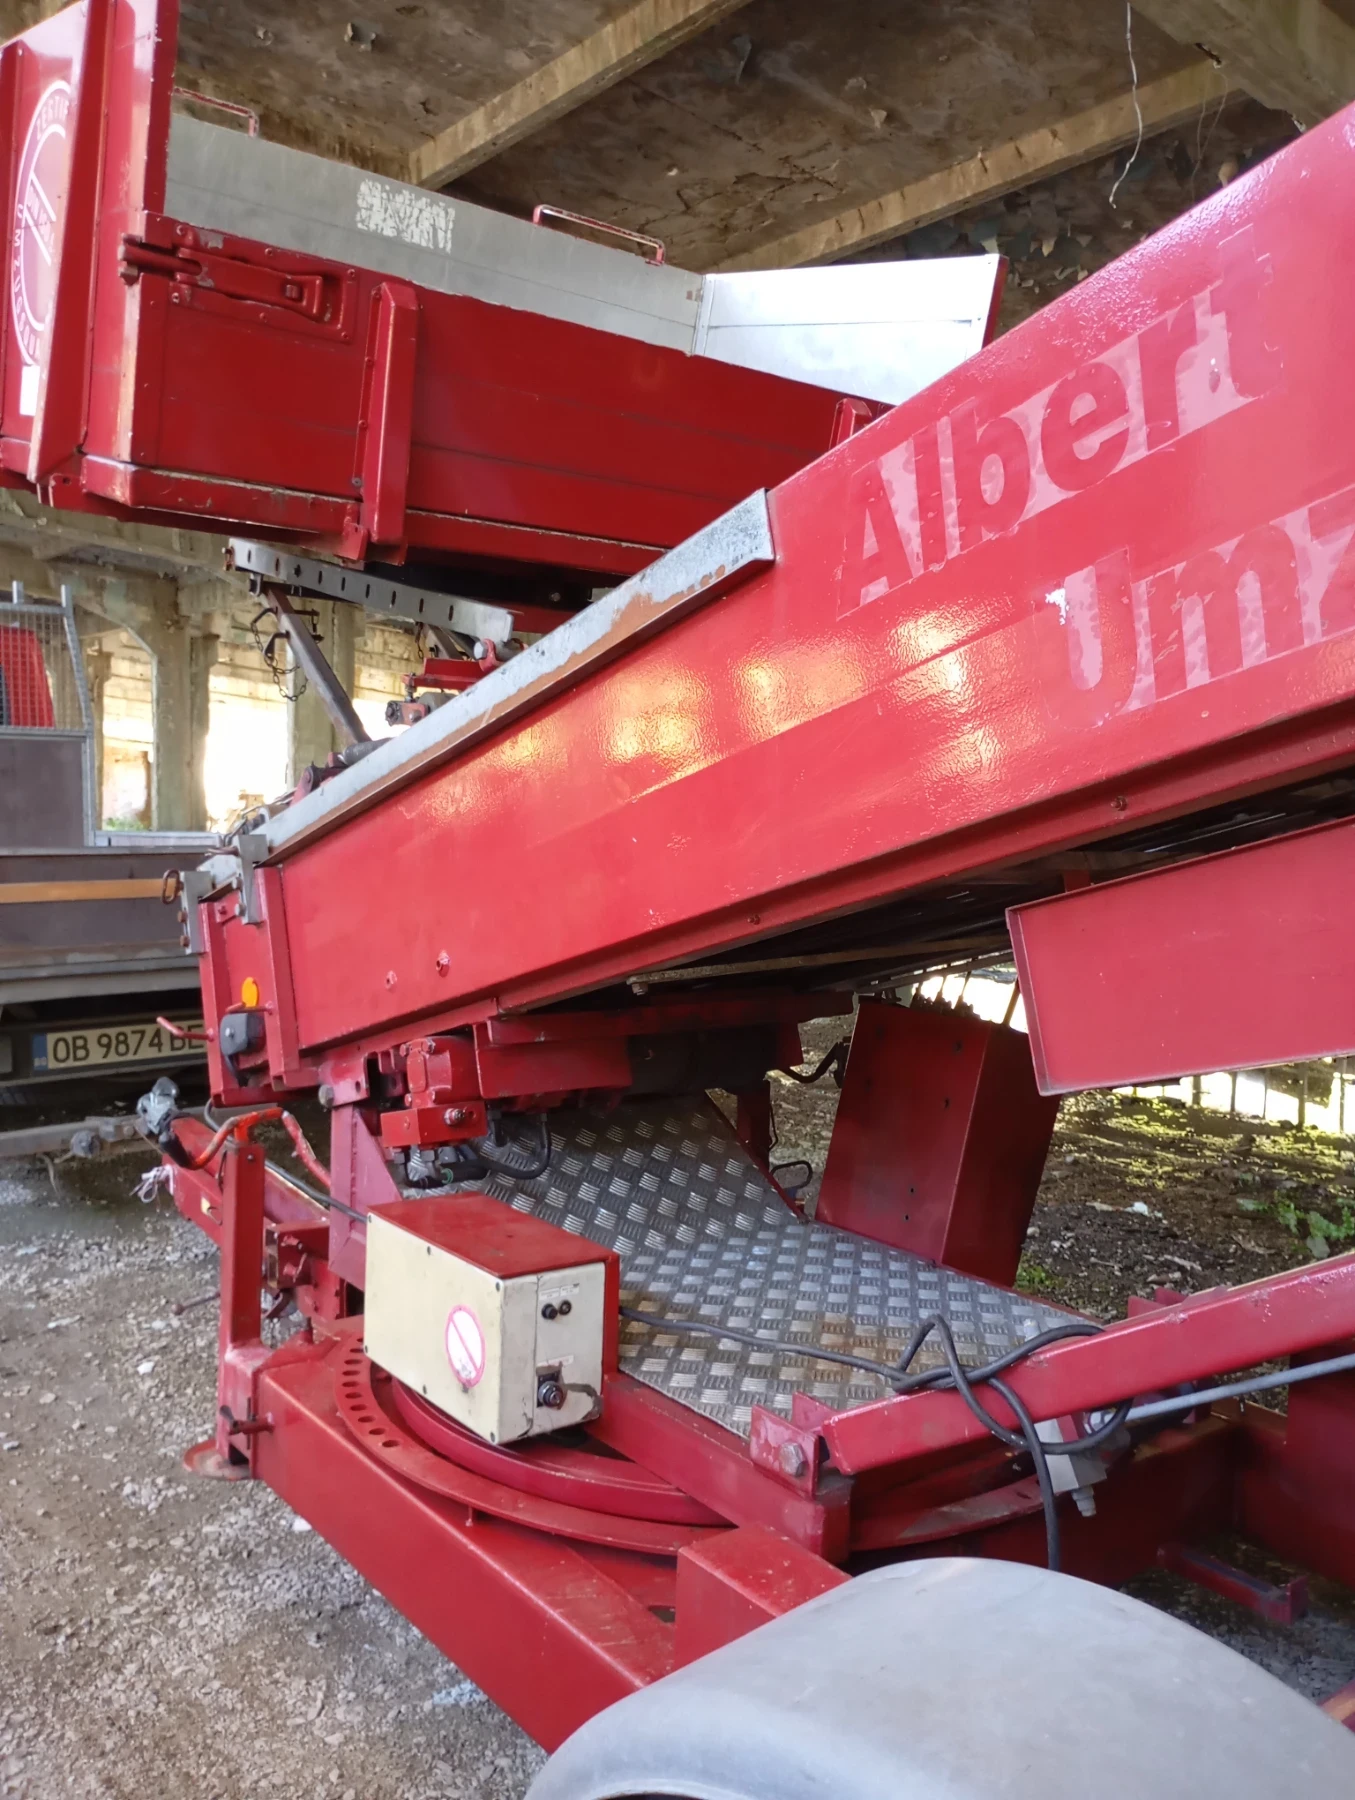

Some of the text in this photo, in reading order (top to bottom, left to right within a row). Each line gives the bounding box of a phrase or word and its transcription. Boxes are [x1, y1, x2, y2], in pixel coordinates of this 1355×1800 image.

[837, 224, 1284, 620] Albert
[53, 1035, 90, 1064] OB
[97, 1028, 163, 1059] 9874
